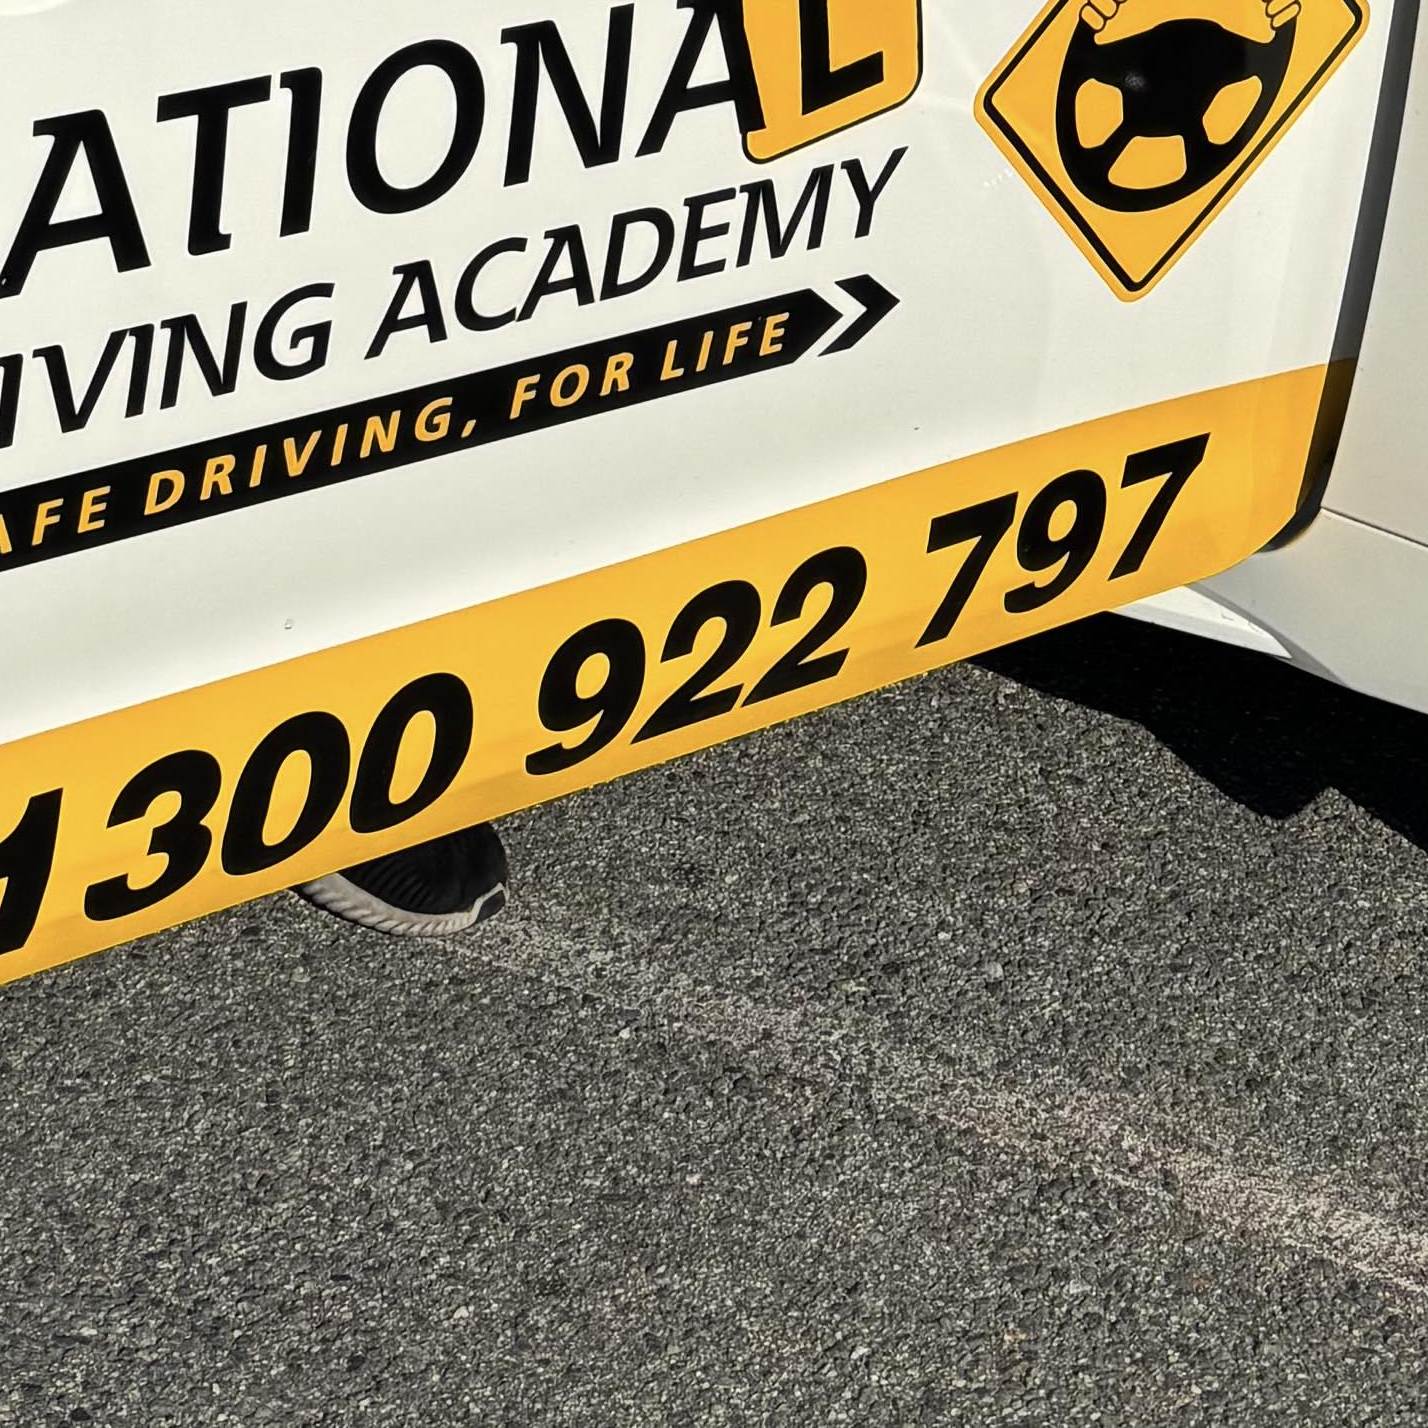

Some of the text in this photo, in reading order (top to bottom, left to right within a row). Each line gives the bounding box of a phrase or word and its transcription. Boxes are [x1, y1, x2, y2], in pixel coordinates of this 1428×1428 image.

[364, 146, 909, 360] ACADEMY
[143, 398, 478, 516] DRIVING,
[509, 352, 634, 420] FOR
[659, 313, 788, 381] LIFE
[526, 546, 868, 776] 922
[915, 433, 1210, 649] 797
